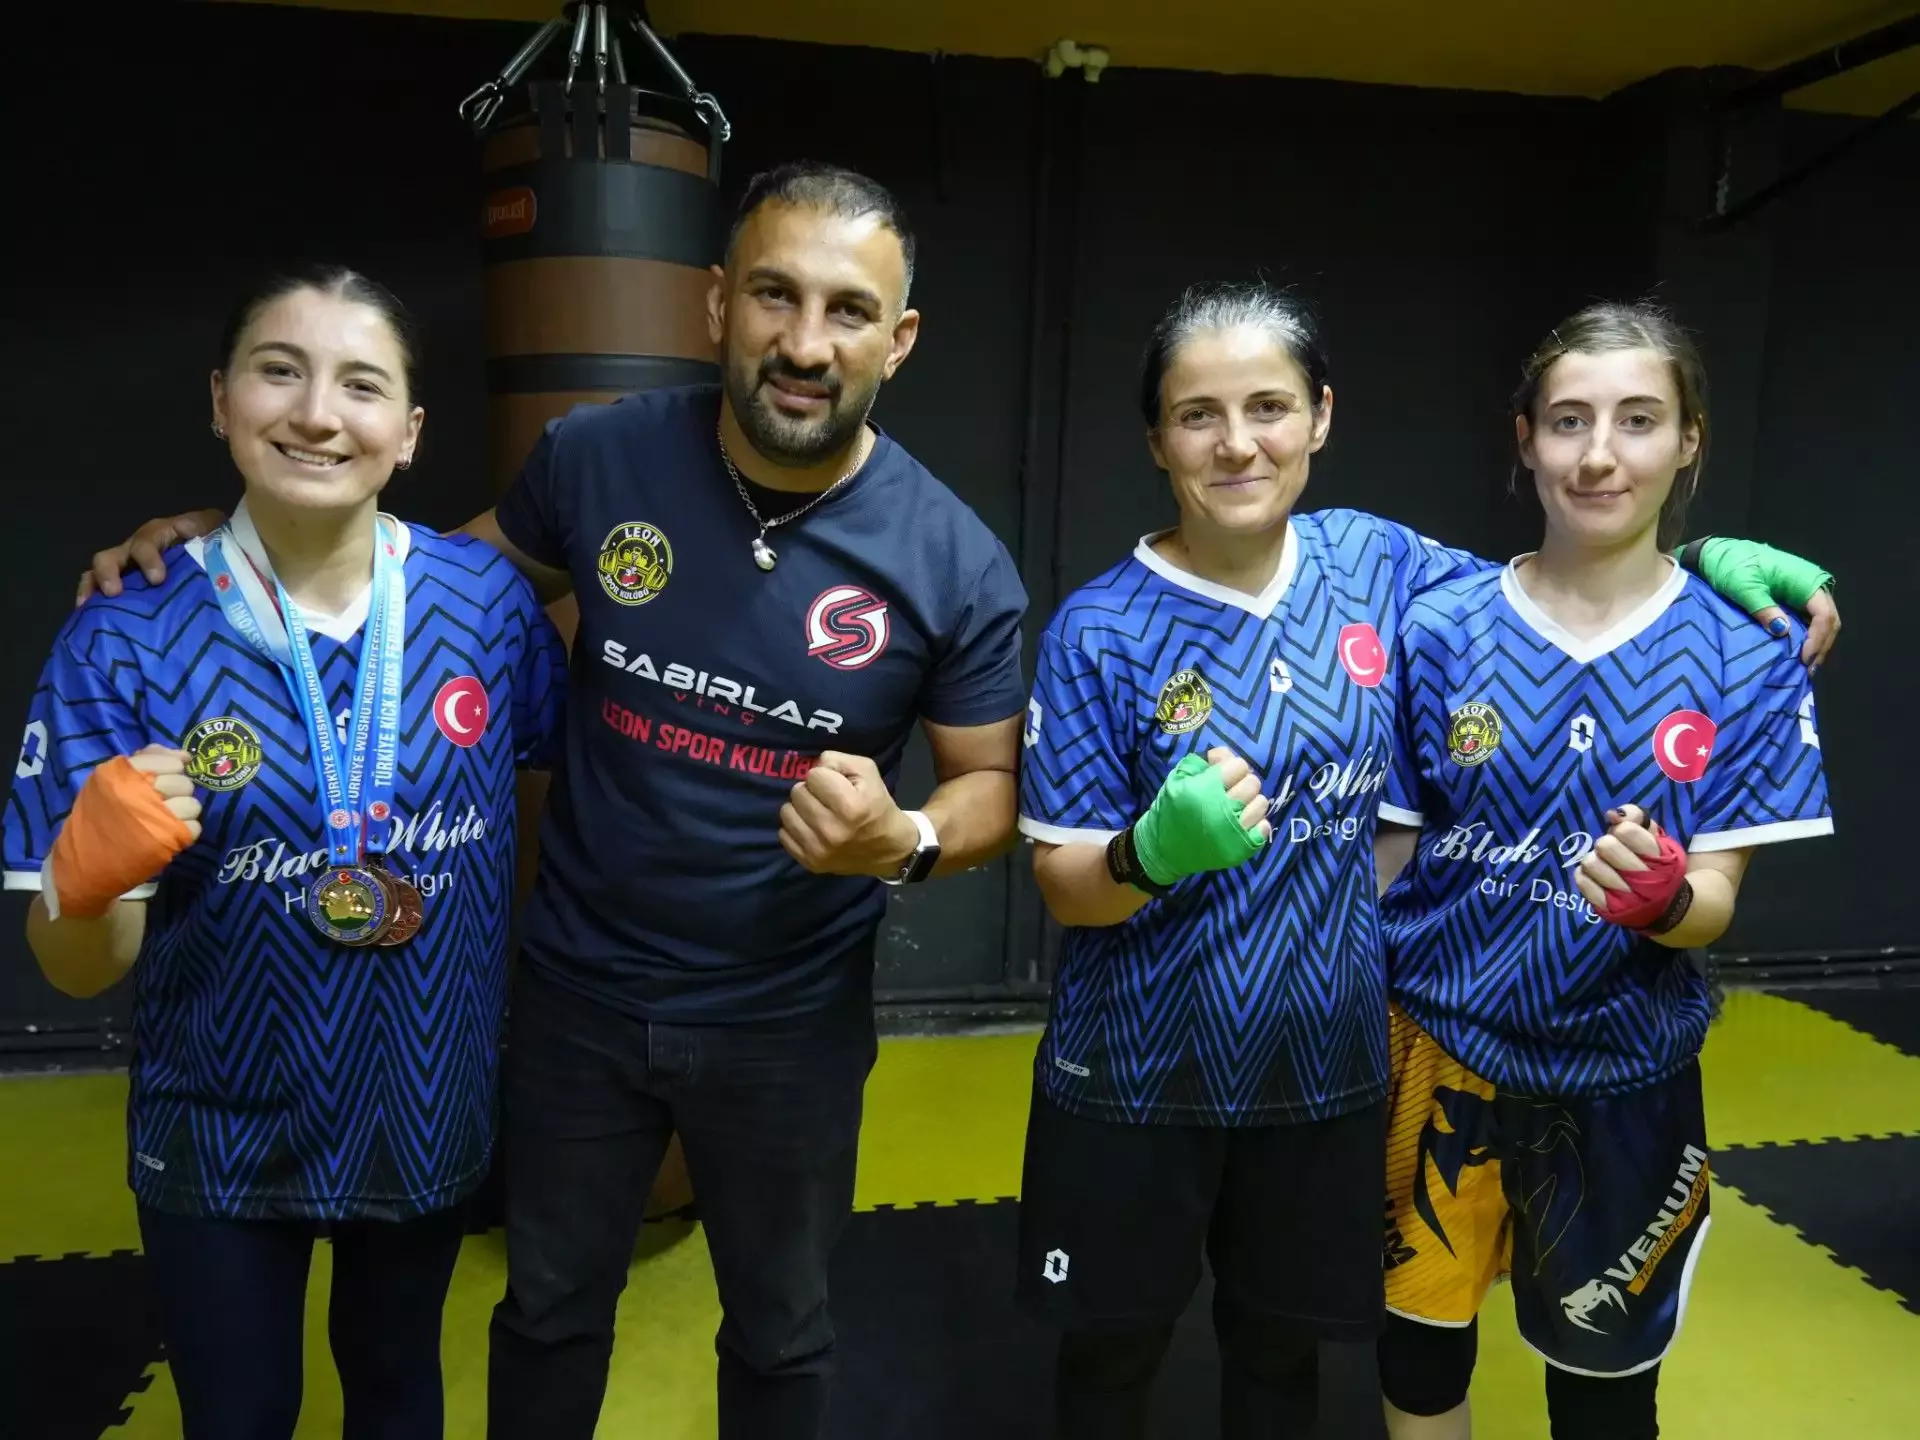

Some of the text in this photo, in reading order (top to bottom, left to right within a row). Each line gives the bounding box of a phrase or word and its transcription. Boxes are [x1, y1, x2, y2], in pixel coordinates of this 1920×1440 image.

[624, 527, 661, 547] LEON
[383, 661, 400, 696] BOKS
[601, 639, 844, 735] SABIRLAR
[197, 721, 235, 738] LEON
[314, 707, 332, 753] WUSHU
[354, 707, 372, 752] WUSHU
[363, 671, 377, 704] KUNG
[602, 697, 652, 744] LEON
[656, 723, 725, 765] SPOR
[1458, 706, 1487, 719] LEON
[371, 732, 396, 787] TÜRKİYE
[217, 800, 489, 884] Blac White
[1475, 874, 1520, 898] air
[1604, 1144, 1708, 1282] VENUM
[1640, 1217, 1686, 1283] TRAINING
